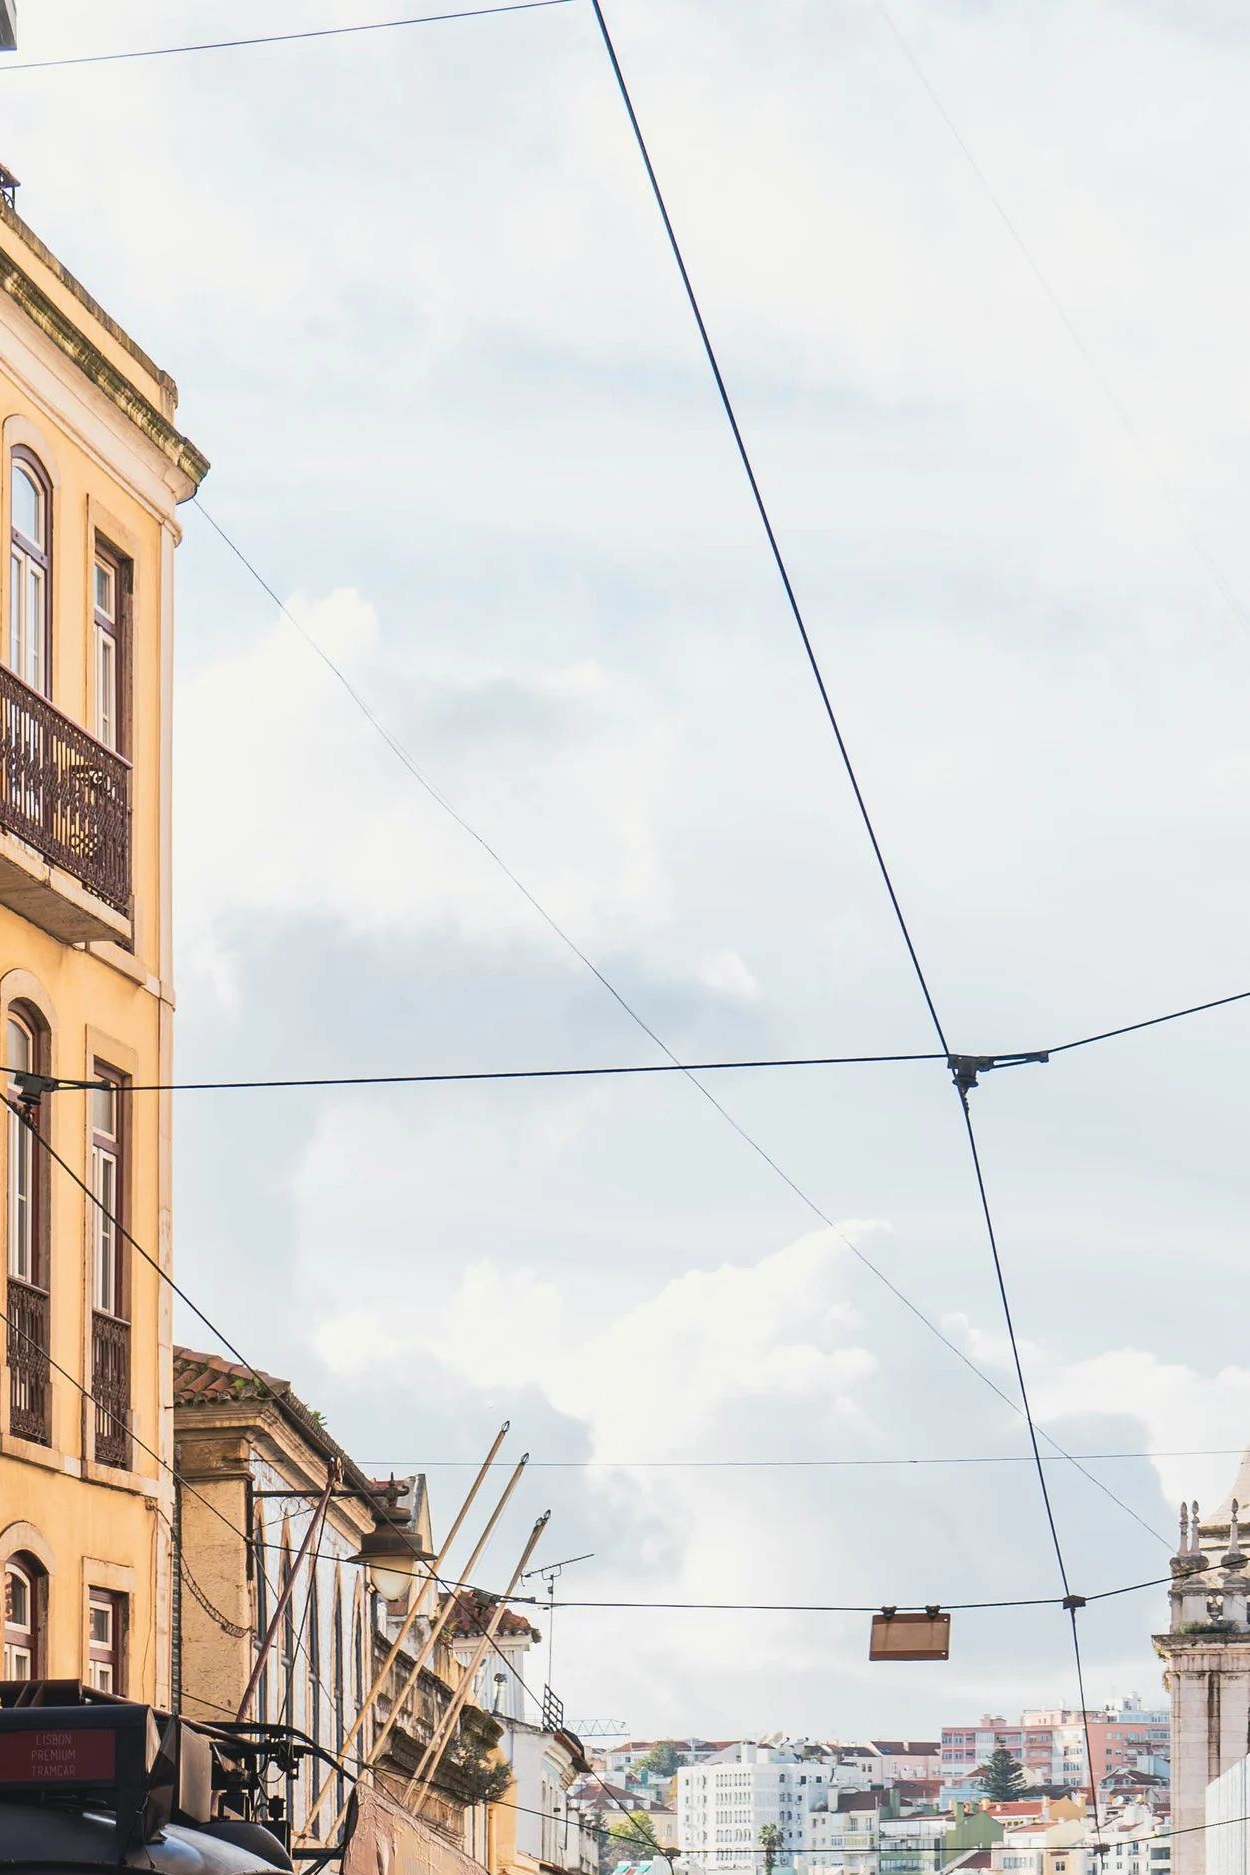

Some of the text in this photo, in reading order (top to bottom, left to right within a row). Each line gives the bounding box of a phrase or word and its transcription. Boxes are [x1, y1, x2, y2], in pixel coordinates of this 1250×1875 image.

[36, 1733, 71, 1746] LISBON
[31, 1749, 77, 1761] PREMIUM
[31, 1764, 77, 1777] TRAMCAR
